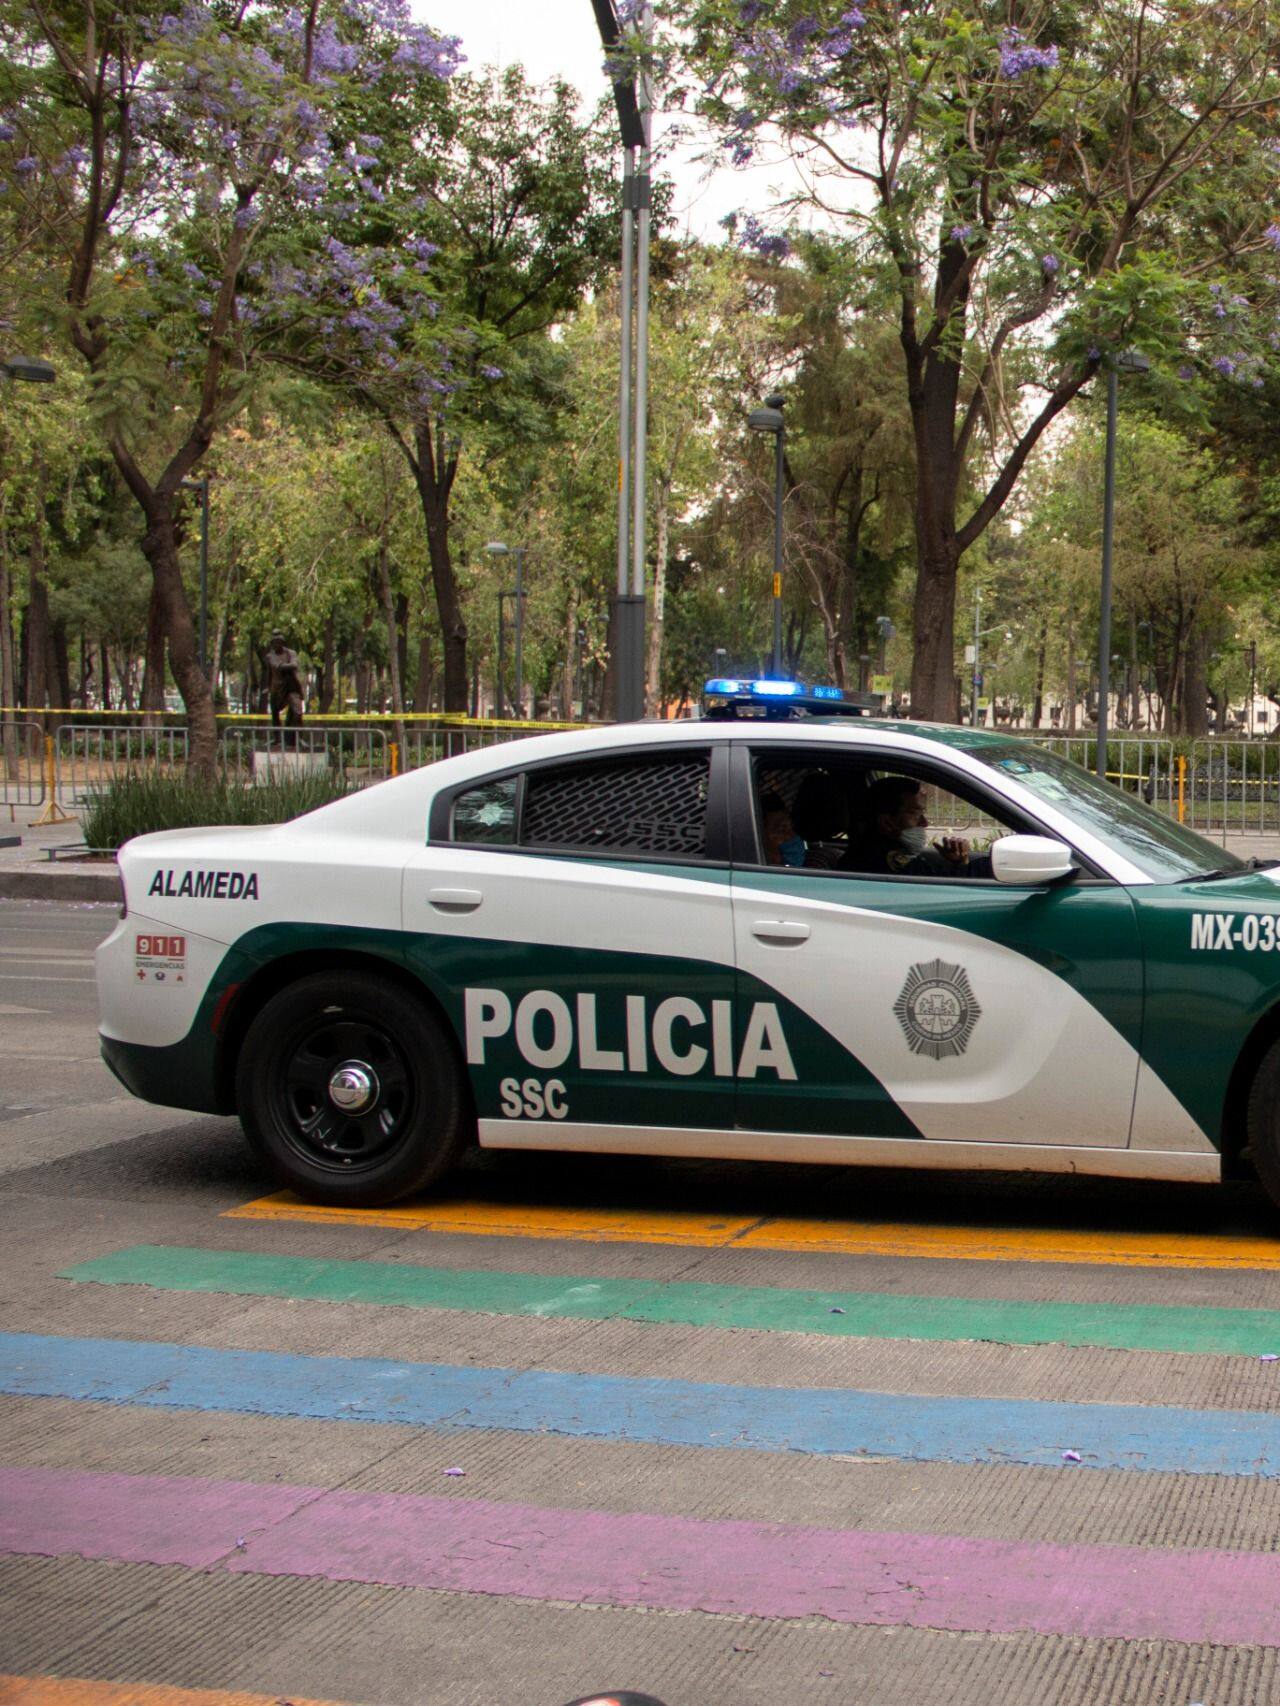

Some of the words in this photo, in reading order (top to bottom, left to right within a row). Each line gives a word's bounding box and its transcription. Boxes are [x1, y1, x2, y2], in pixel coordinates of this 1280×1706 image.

[632, 822, 701, 839] SSC
[148, 870, 259, 900] ALAMEDA
[138, 937, 182, 954] 911
[465, 987, 798, 1081] POLICIA
[500, 1077, 569, 1119] SSC
